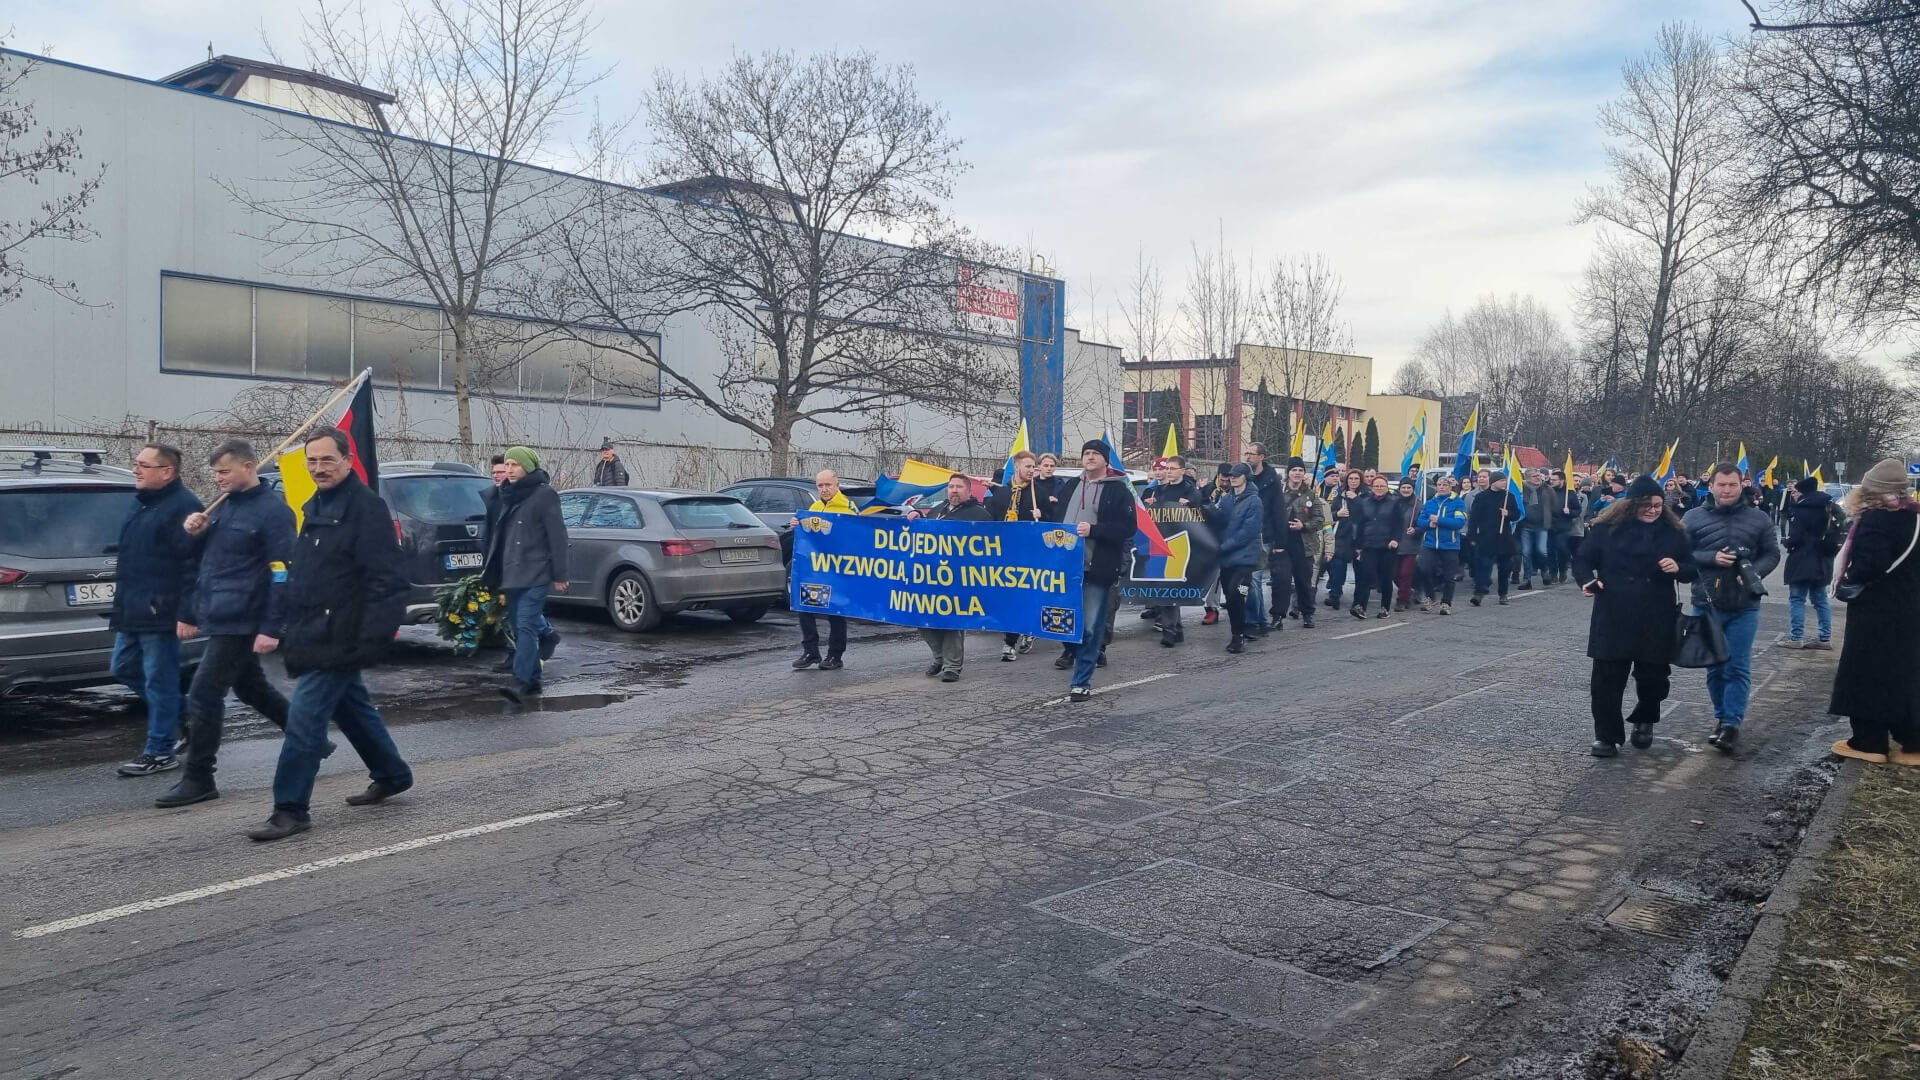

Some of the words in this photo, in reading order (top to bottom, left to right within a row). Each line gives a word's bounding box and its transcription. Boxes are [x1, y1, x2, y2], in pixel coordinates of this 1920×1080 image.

[1162, 507, 1205, 523] PAMIYNTA
[960, 565, 1067, 594] INKSZYCH
[80, 585, 101, 600] SK
[1139, 587, 1204, 599] NIYZGODY
[889, 589, 986, 617] NIYWOLA
